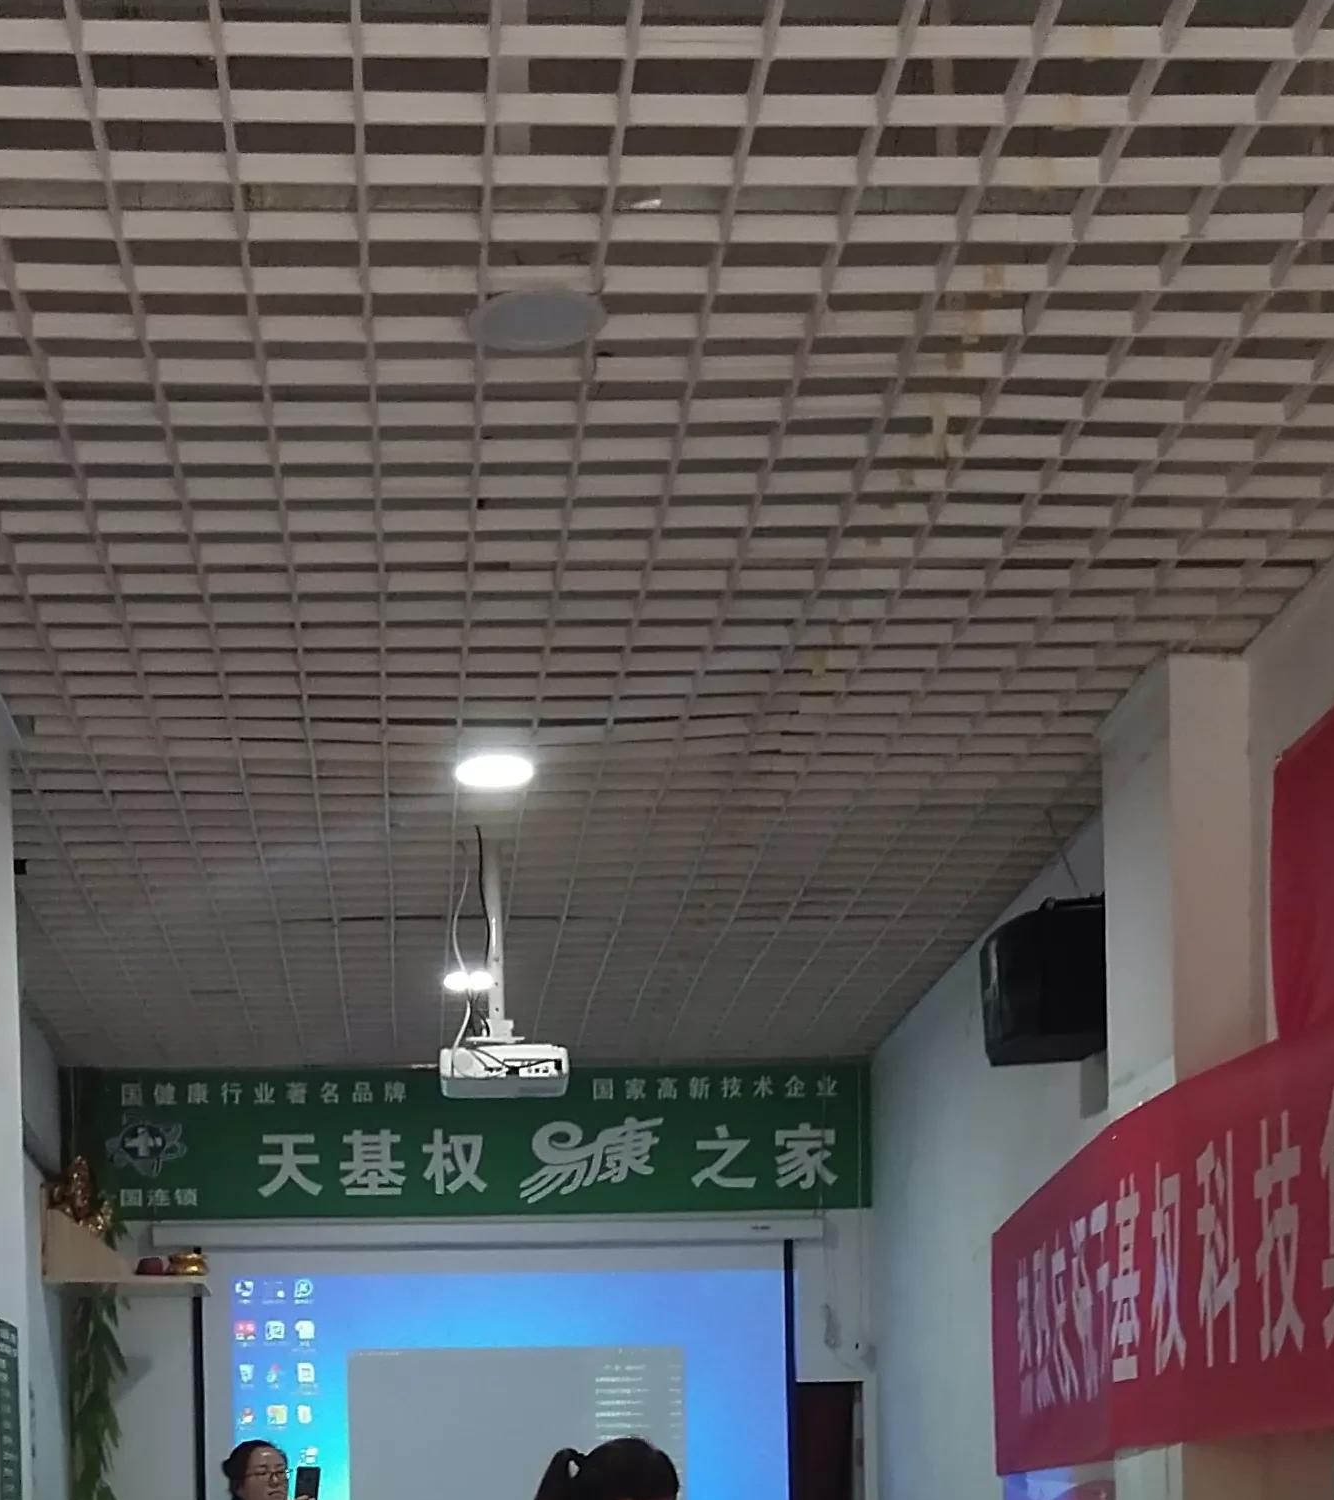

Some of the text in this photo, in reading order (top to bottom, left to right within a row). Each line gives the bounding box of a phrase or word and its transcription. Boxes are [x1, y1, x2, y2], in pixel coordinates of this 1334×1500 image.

[593, 1075, 839, 1101] 国家高新技术企业
